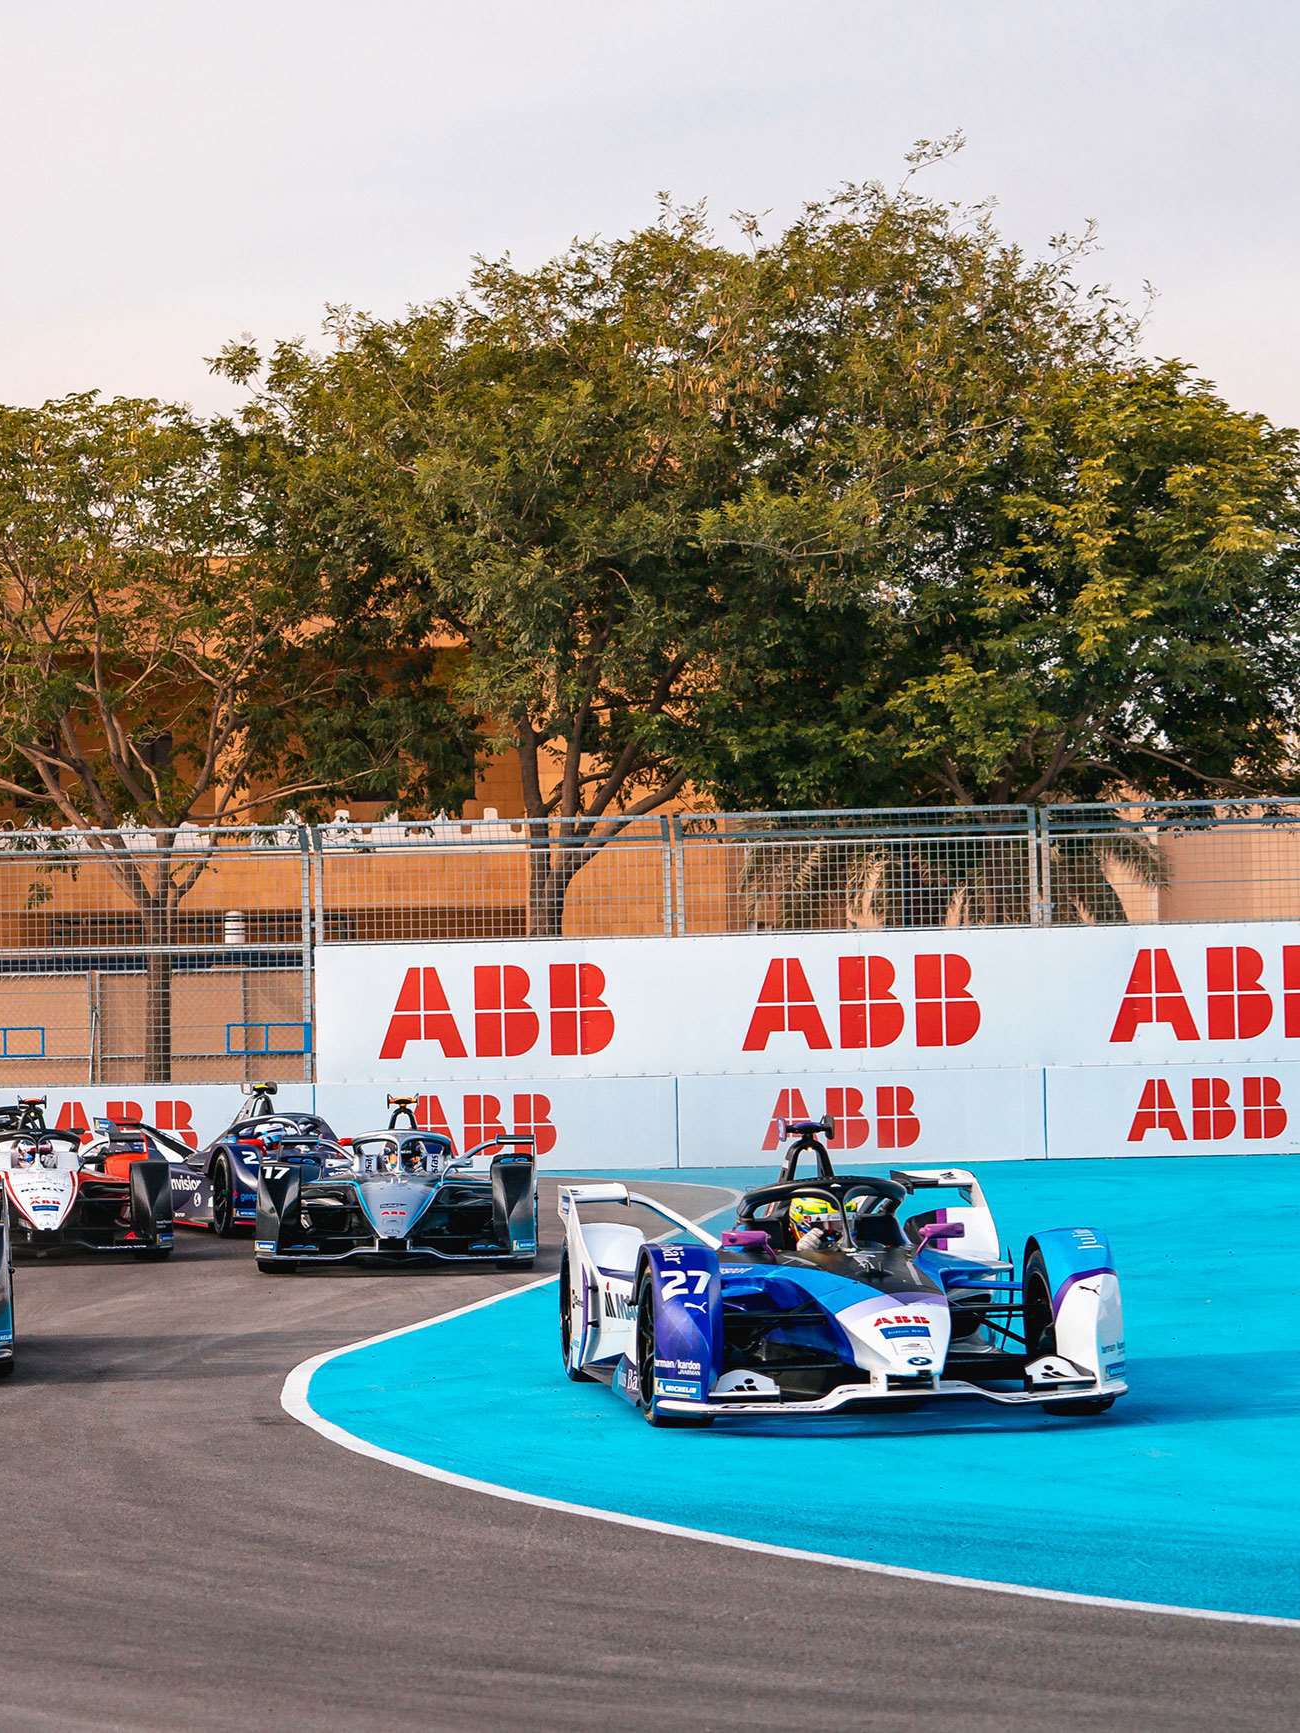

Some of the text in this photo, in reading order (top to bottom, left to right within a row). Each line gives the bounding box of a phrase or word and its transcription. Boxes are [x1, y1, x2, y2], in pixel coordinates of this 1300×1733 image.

[380, 964, 615, 1059] ABB
[743, 954, 981, 1051] ABB
[1111, 945, 1300, 1042] AB
[413, 1094, 557, 1156] ABB
[762, 1086, 921, 1151] ABB
[1128, 1077, 1288, 1142] ABB
[262, 1166, 290, 1180] 17
[660, 1270, 711, 1302] 27
[874, 1315, 931, 1328] ABB
